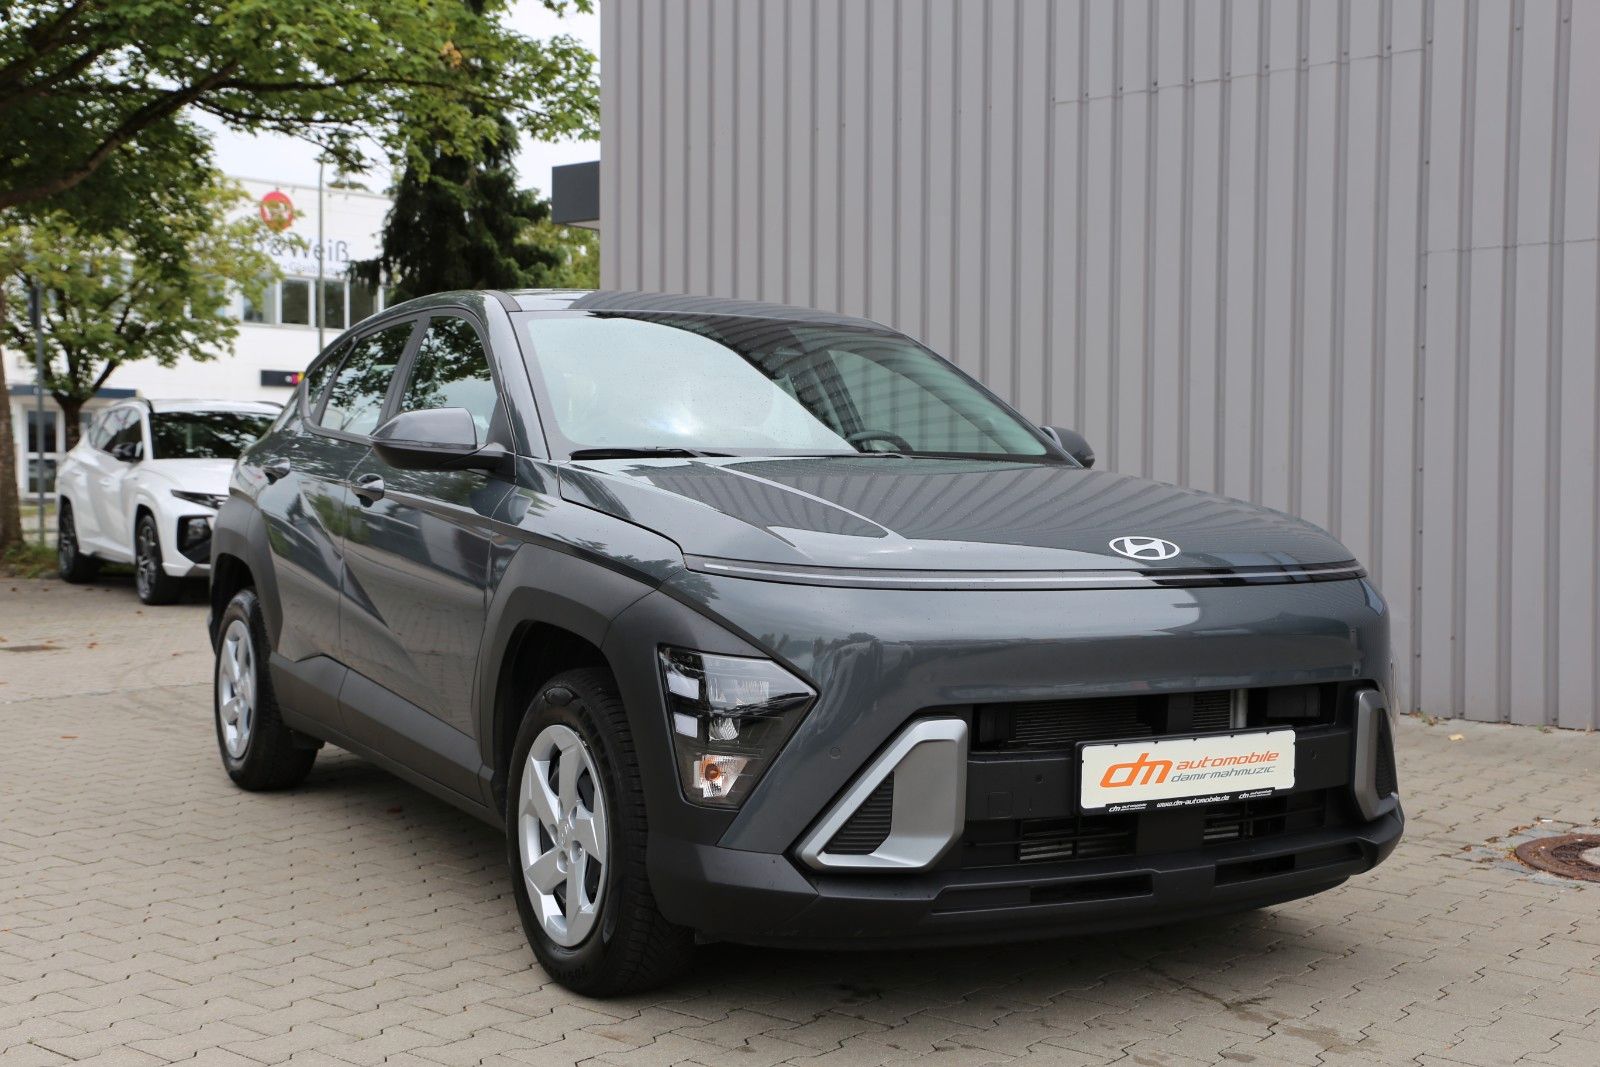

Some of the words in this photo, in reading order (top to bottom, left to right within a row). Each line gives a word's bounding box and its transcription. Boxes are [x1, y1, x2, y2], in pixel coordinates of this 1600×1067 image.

[1099, 752, 1173, 788] dm
[1176, 750, 1279, 771] automobile
[1170, 766, 1276, 783] damirmahmuzic
